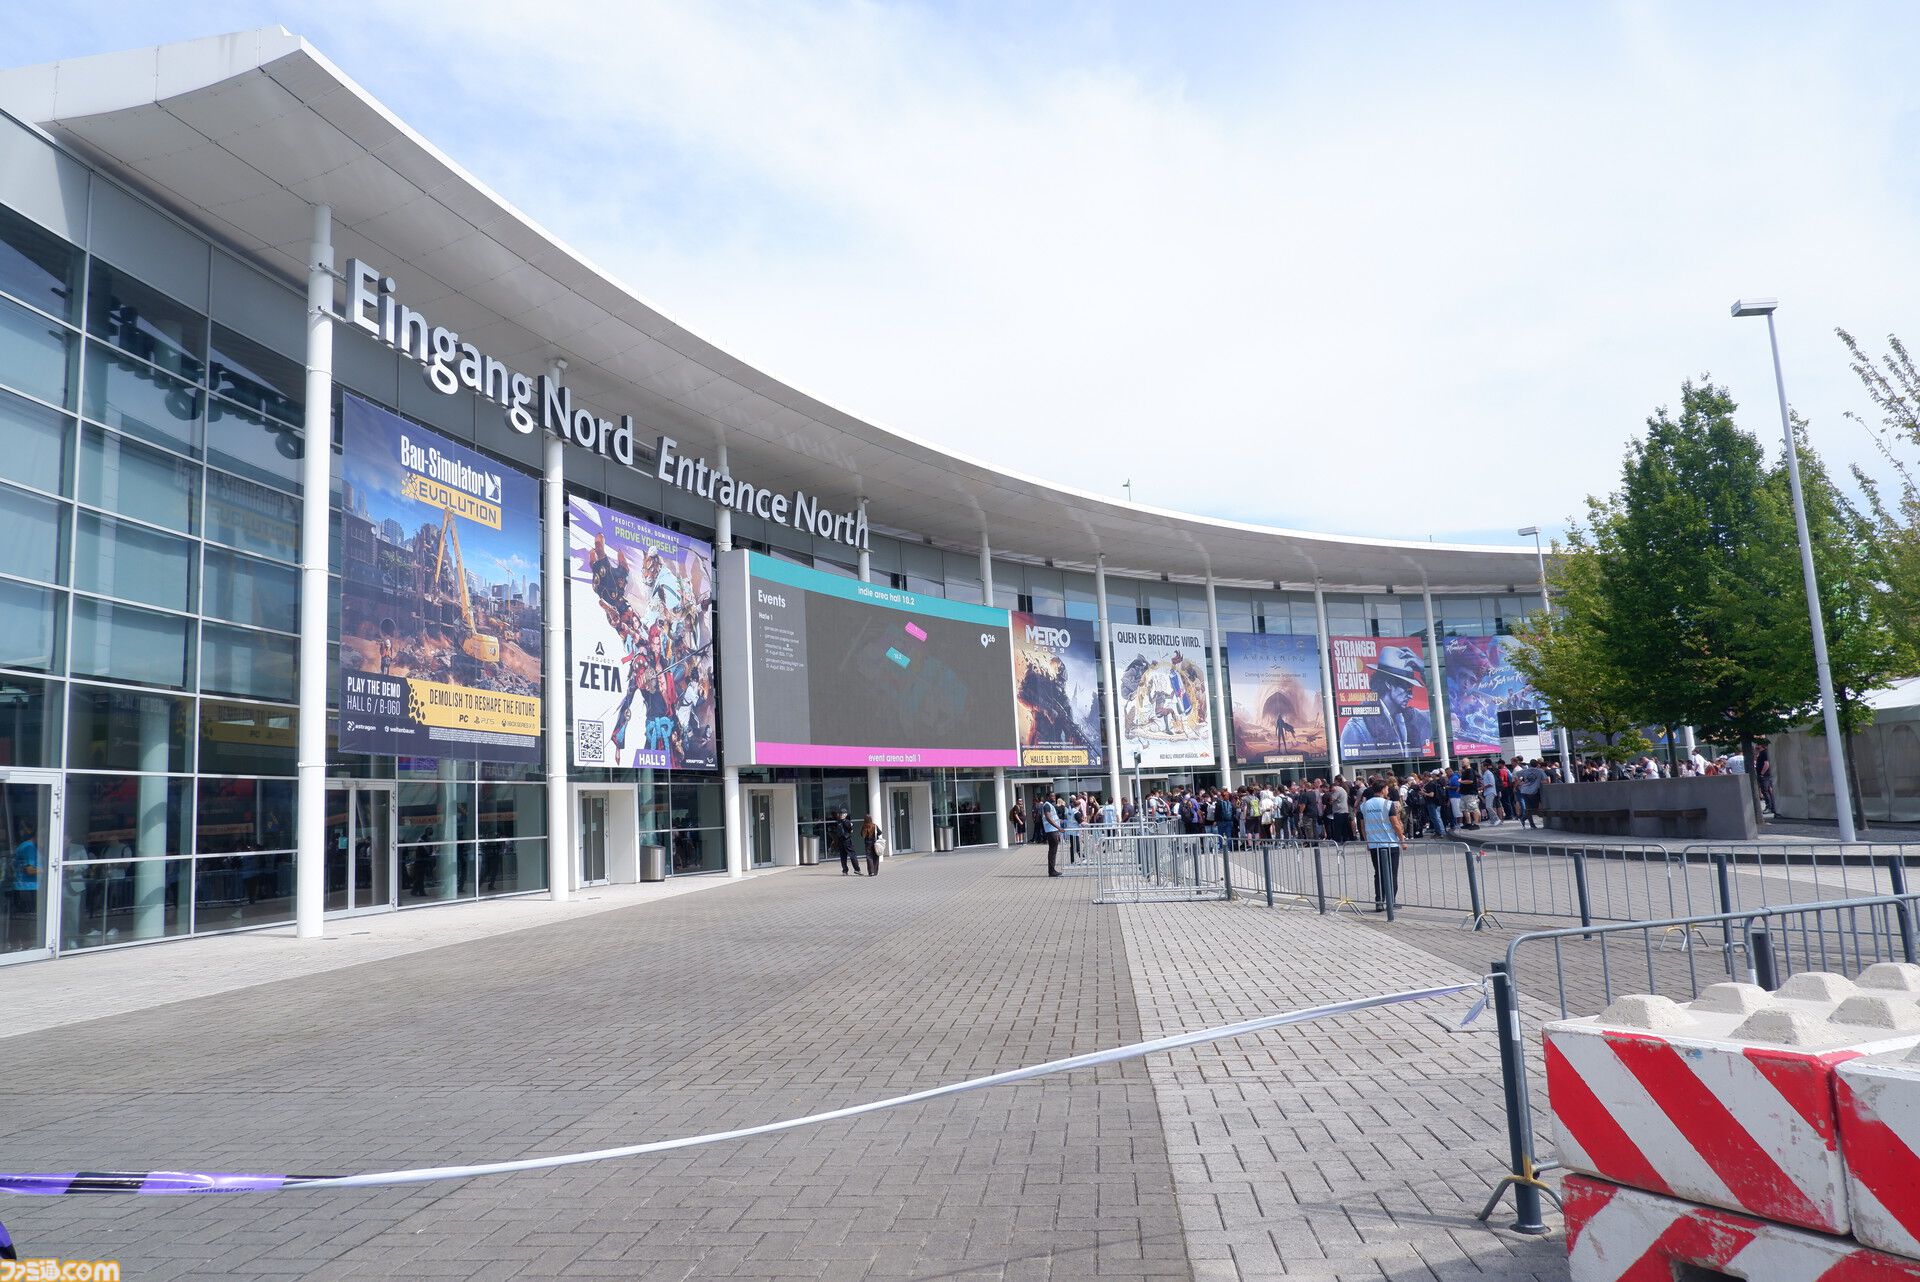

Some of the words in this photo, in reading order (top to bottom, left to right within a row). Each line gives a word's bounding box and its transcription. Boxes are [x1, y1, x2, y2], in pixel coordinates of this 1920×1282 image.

[346, 257, 534, 435] Eingang
[538, 374, 633, 466] Nord
[656, 435, 789, 525] Entrance
[791, 490, 869, 550] North
[400, 434, 485, 496] Bau-Simulator
[419, 481, 497, 524] EVOLUTION
[614, 526, 641, 544] PROVE
[641, 534, 678, 555] YOURSELF
[654, 530, 680, 544] DOMINATE
[757, 589, 786, 608] Events
[857, 586, 873, 598] indie
[874, 591, 889, 600] area
[889, 592, 901, 602] hall
[987, 634, 996, 643] 26
[1025, 624, 1071, 648] METRO
[1117, 631, 1137, 644] QUEN
[1138, 633, 1147, 645] ES
[1181, 636, 1201, 648] WIRD.
[1333, 640, 1377, 658] STRANGER
[1335, 656, 1358, 674] THAN
[579, 660, 622, 693] ZETA
[1337, 672, 1371, 690] HEAVEN
[347, 676, 366, 694] PLAY
[367, 679, 380, 696] THE
[381, 681, 401, 699] DEMO
[346, 695, 365, 712] HALL
[366, 697, 372, 713] 6
[379, 698, 401, 716] B-060
[429, 688, 463, 708] DEMOLISH
[465, 693, 473, 709] TO
[474, 695, 501, 713] RESHAPE
[503, 699, 513, 715] THE
[515, 700, 536, 717] FUTURE
[458, 714, 469, 722] PC
[354, 724, 377, 732] astragon
[639, 753, 660, 766] HALL
[660, 754, 666, 766] 9
[868, 753, 885, 762] event
[886, 755, 904, 763] arena
[905, 753, 916, 763] hall
[1030, 755, 1045, 764] HALLE
